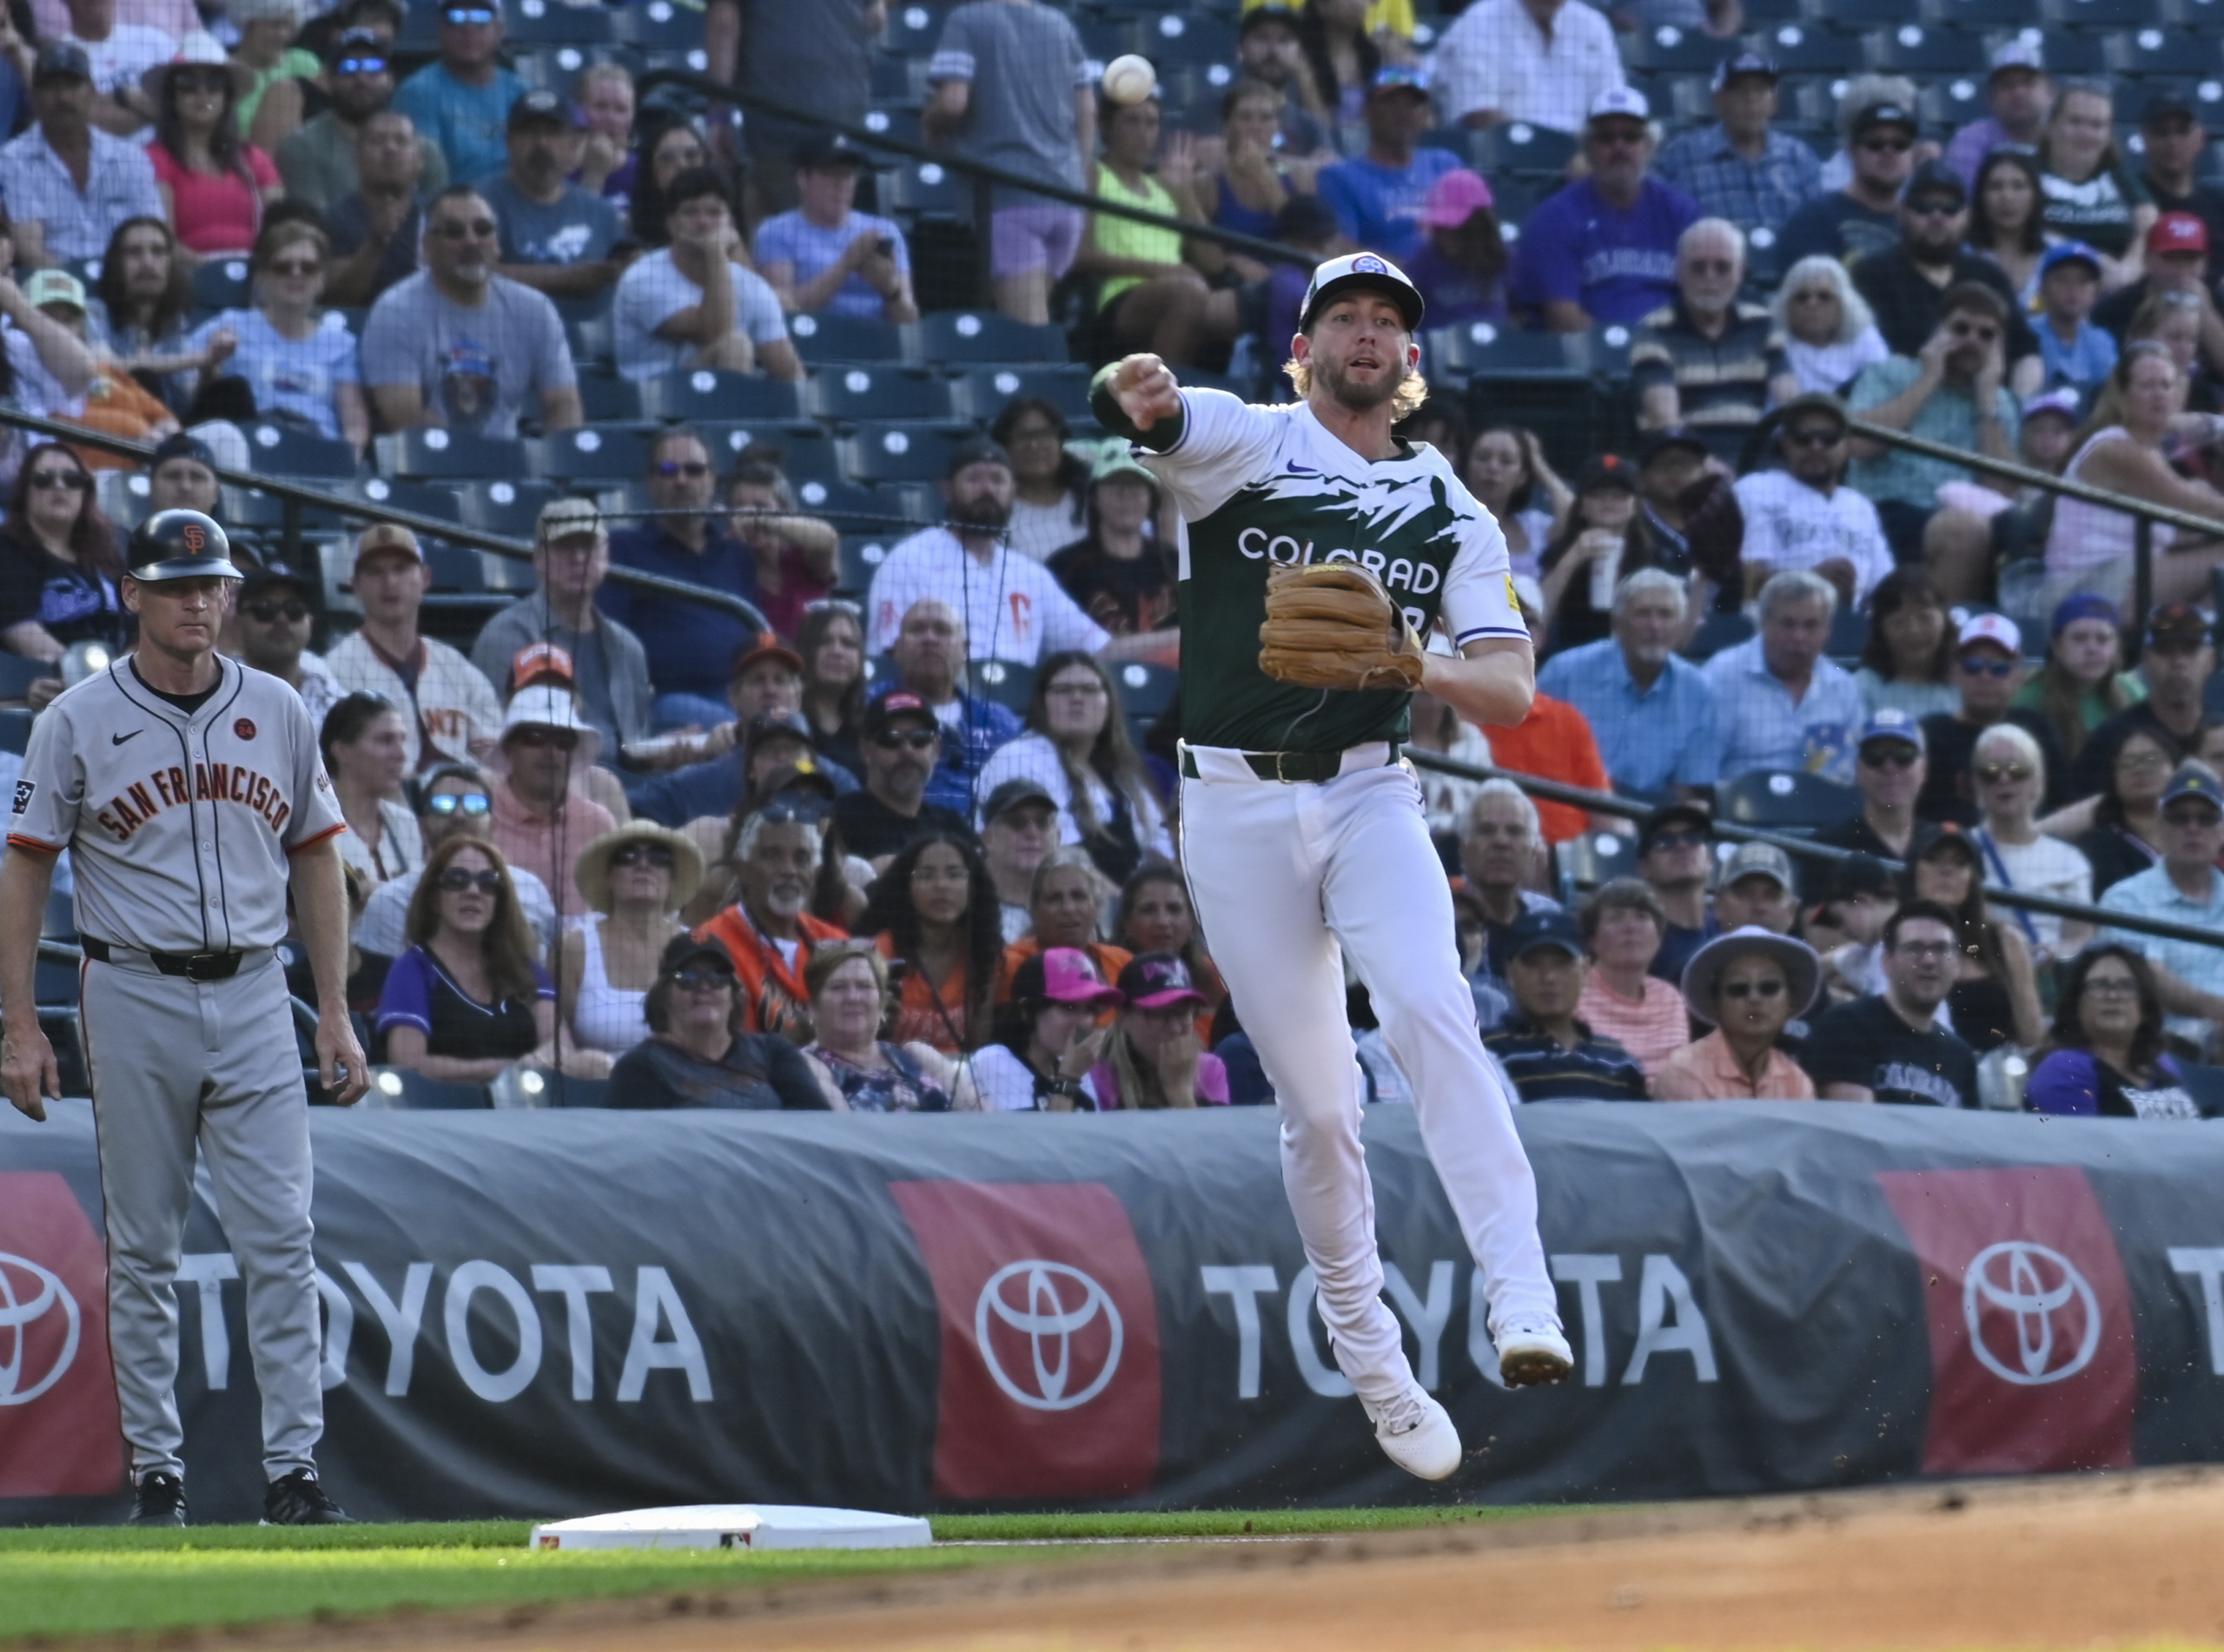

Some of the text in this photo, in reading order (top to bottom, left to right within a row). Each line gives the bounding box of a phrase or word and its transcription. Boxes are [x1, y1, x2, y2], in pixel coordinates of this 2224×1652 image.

[1359, 257, 1382, 269] CO
[184, 525, 205, 555] SF
[97, 763, 290, 842] SAN FRANCISCO
